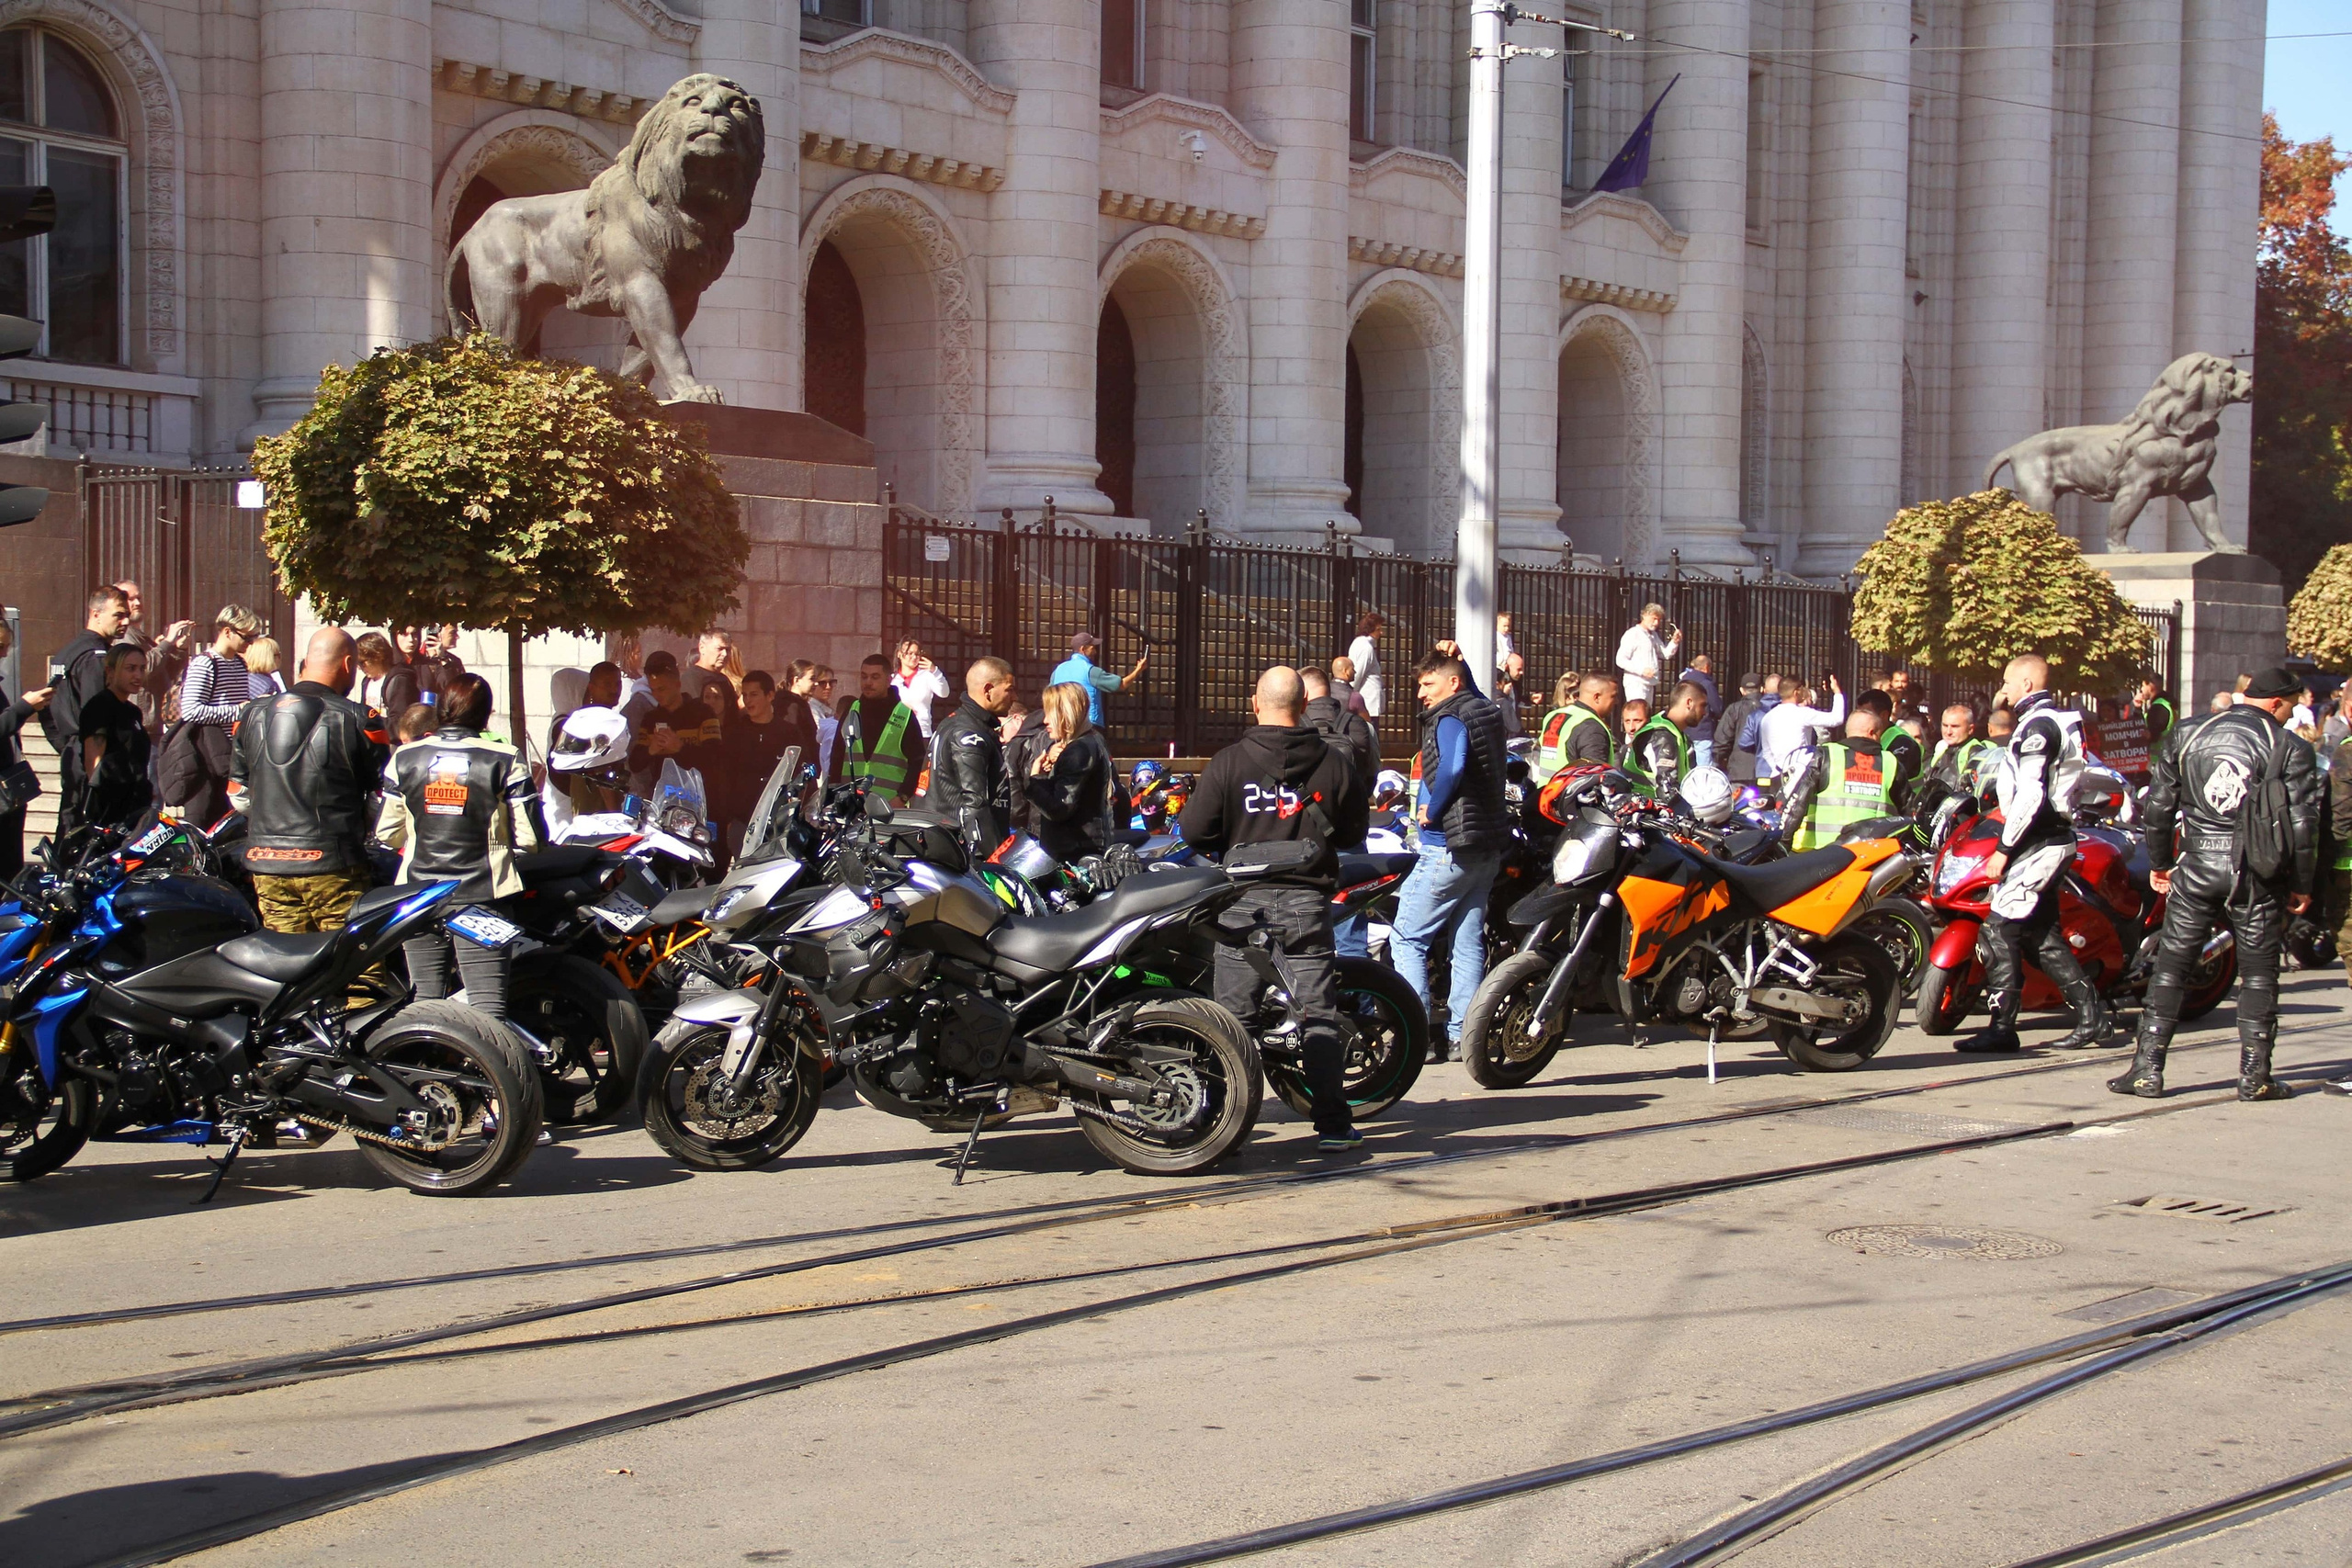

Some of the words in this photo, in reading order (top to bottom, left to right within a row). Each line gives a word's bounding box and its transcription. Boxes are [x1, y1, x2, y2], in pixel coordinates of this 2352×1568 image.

[2098, 720, 2133, 731] УБИЙЦИТЕ
[2103, 747, 2148, 760] ЗАТВОРА!
[1847, 772, 1881, 784] ПРОТЕСТ
[427, 787, 465, 799] ПРОТЕСТ
[146, 827, 175, 855] NOLAN
